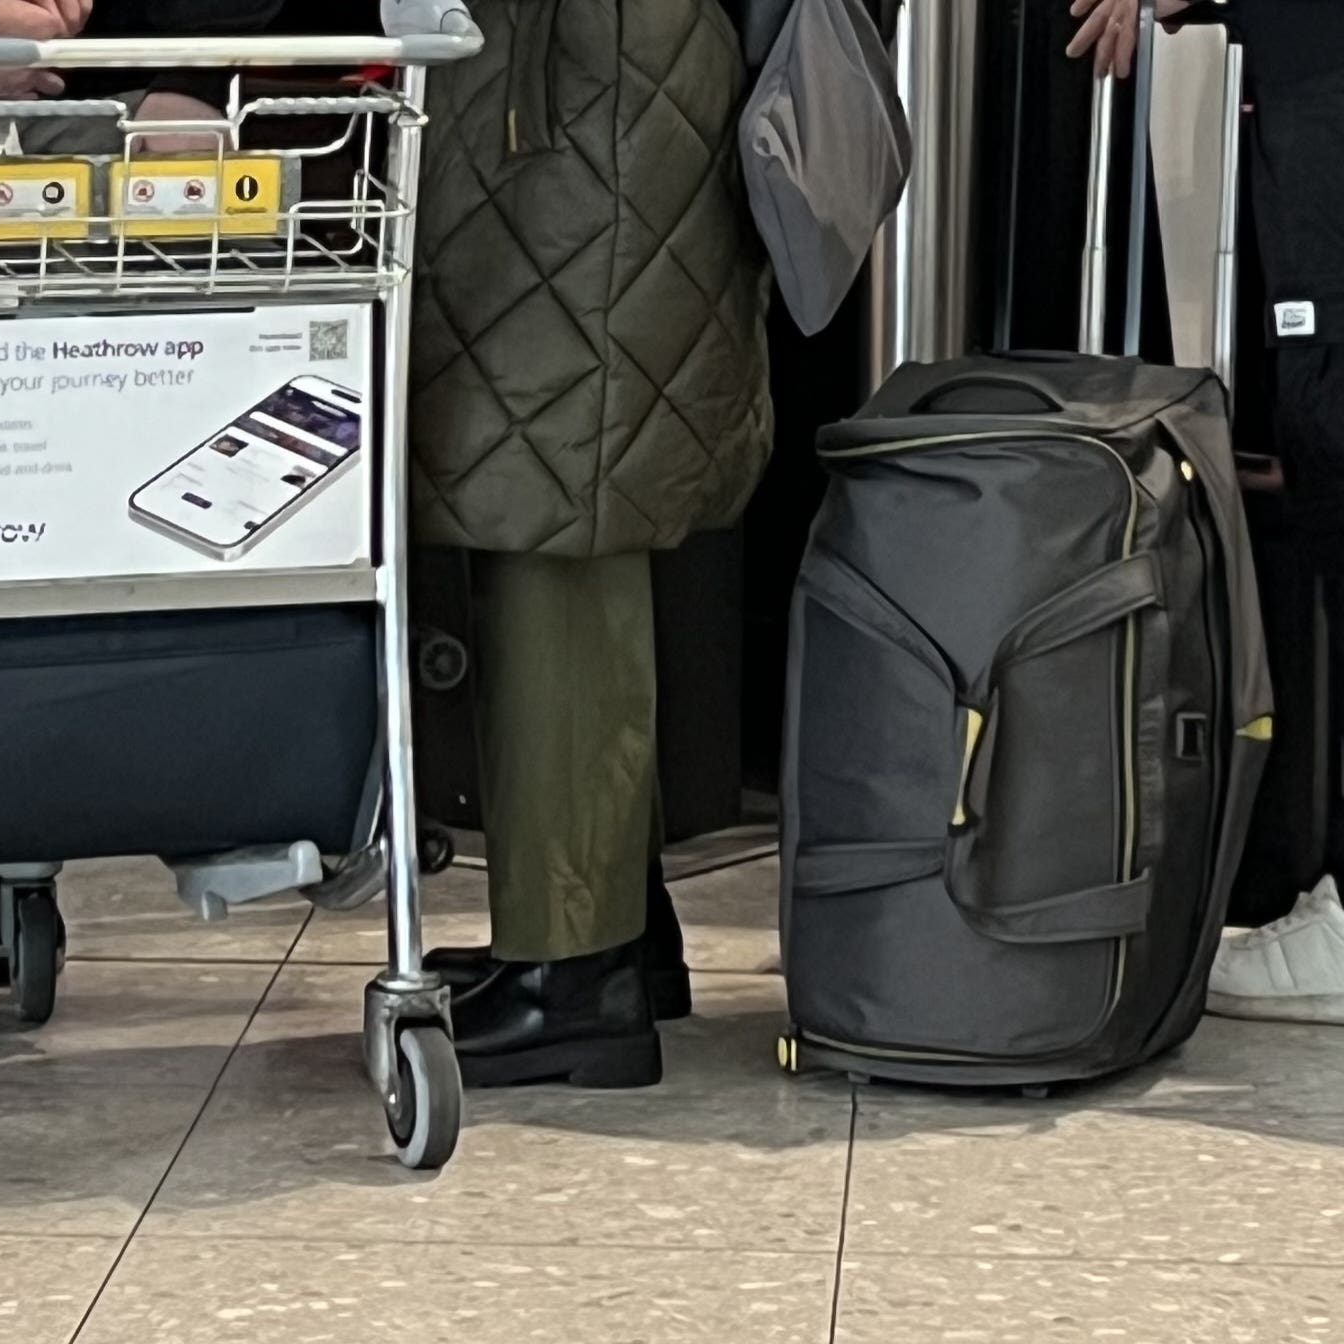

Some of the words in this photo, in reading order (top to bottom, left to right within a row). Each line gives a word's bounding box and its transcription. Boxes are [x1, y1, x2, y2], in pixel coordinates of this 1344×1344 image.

[14, 342, 46, 362] the
[52, 339, 159, 360] Heathrow
[163, 340, 204, 360] app
[0, 375, 44, 396] your
[50, 370, 128, 395] journey
[133, 368, 195, 387] better
